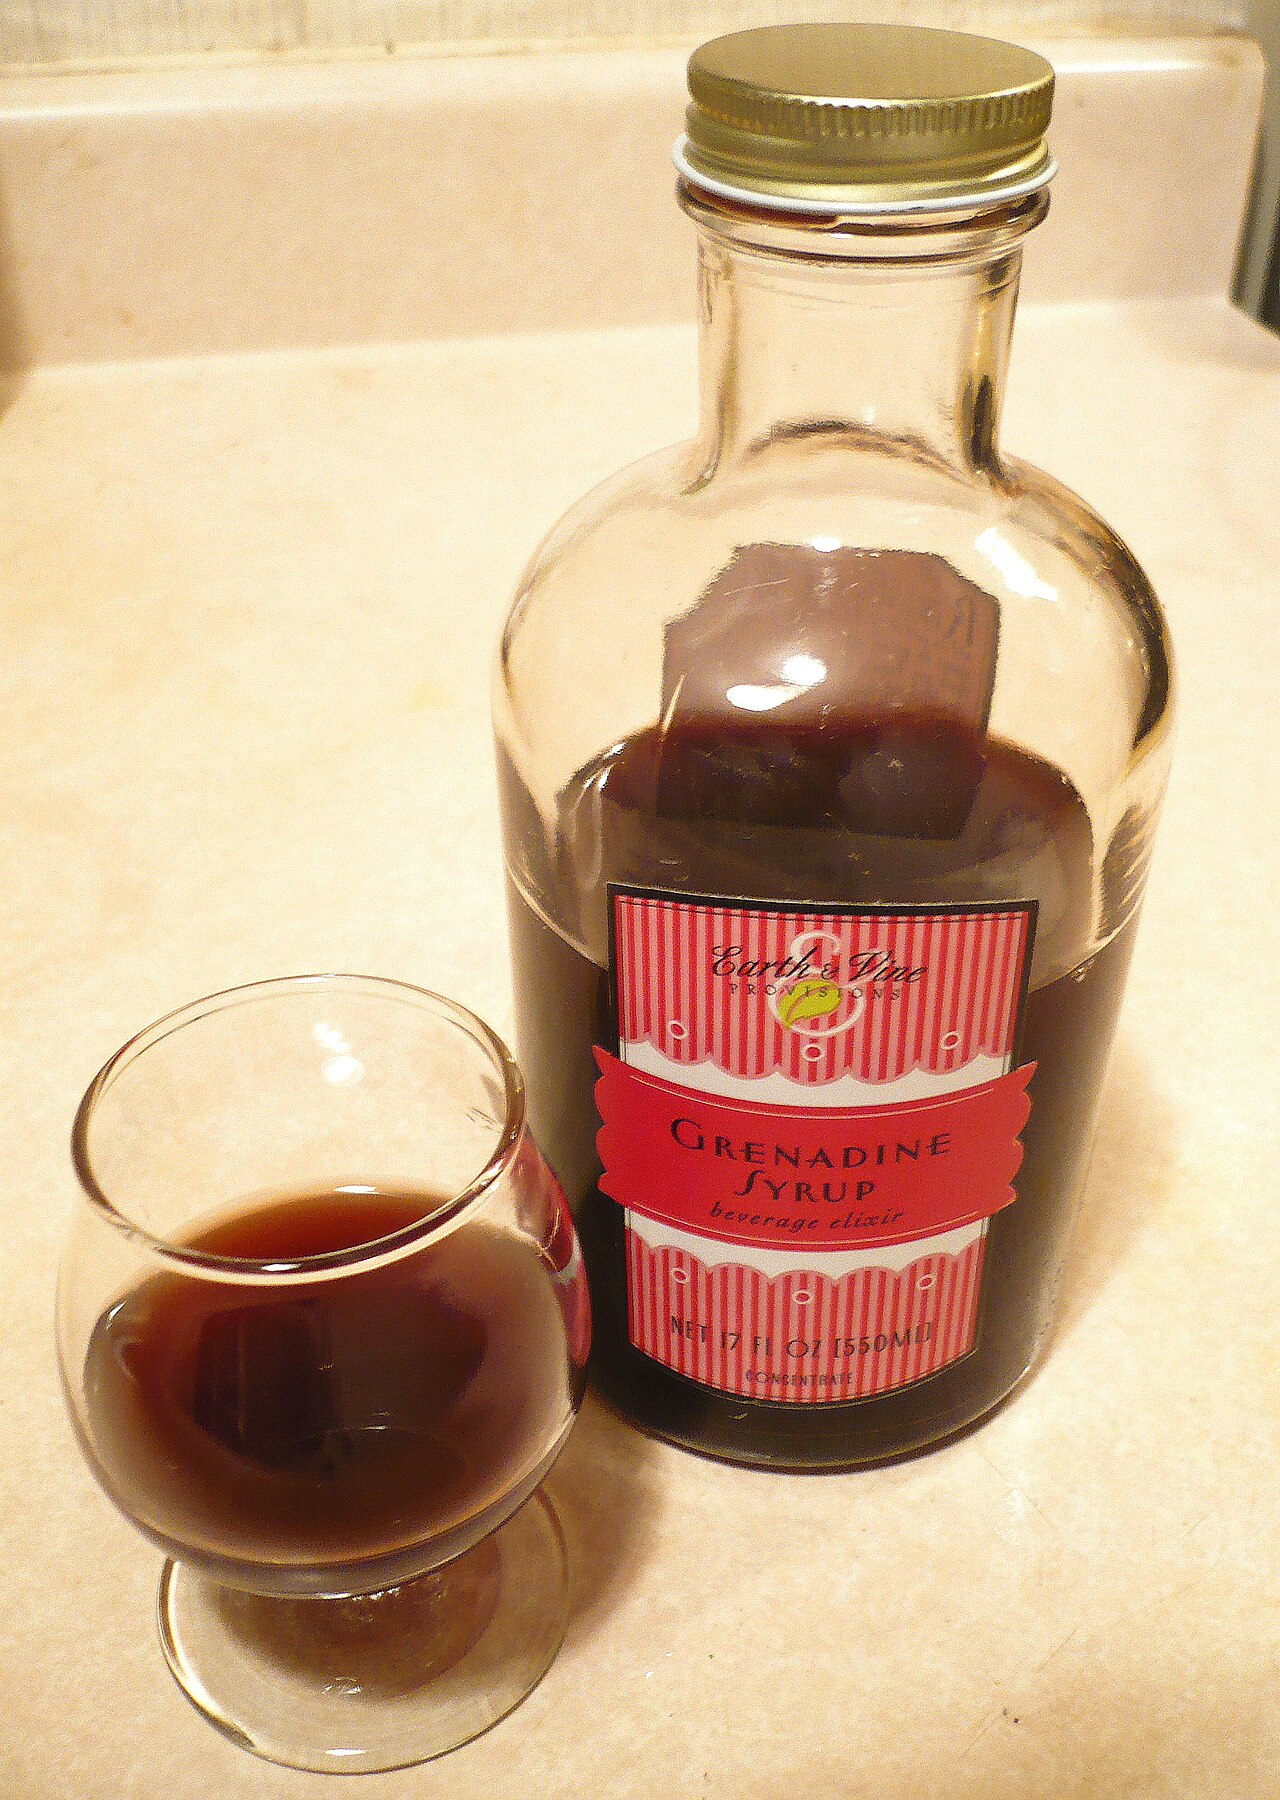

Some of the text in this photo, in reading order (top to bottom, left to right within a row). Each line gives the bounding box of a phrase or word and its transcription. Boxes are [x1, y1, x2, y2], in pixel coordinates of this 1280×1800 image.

[711, 945, 819, 980] Earth
[848, 948, 927, 984] Vine
[730, 983, 902, 1001] PROVISIONS
[670, 1118, 951, 1169] GRENADINE
[735, 1170, 877, 1204] SYRUP
[709, 1202, 906, 1231] beverage elixir
[671, 1316, 709, 1343] NET
[721, 1332, 741, 1351] 17
[787, 1339, 821, 1358] OZ
[745, 1370, 852, 1386] CONCENTRATE
